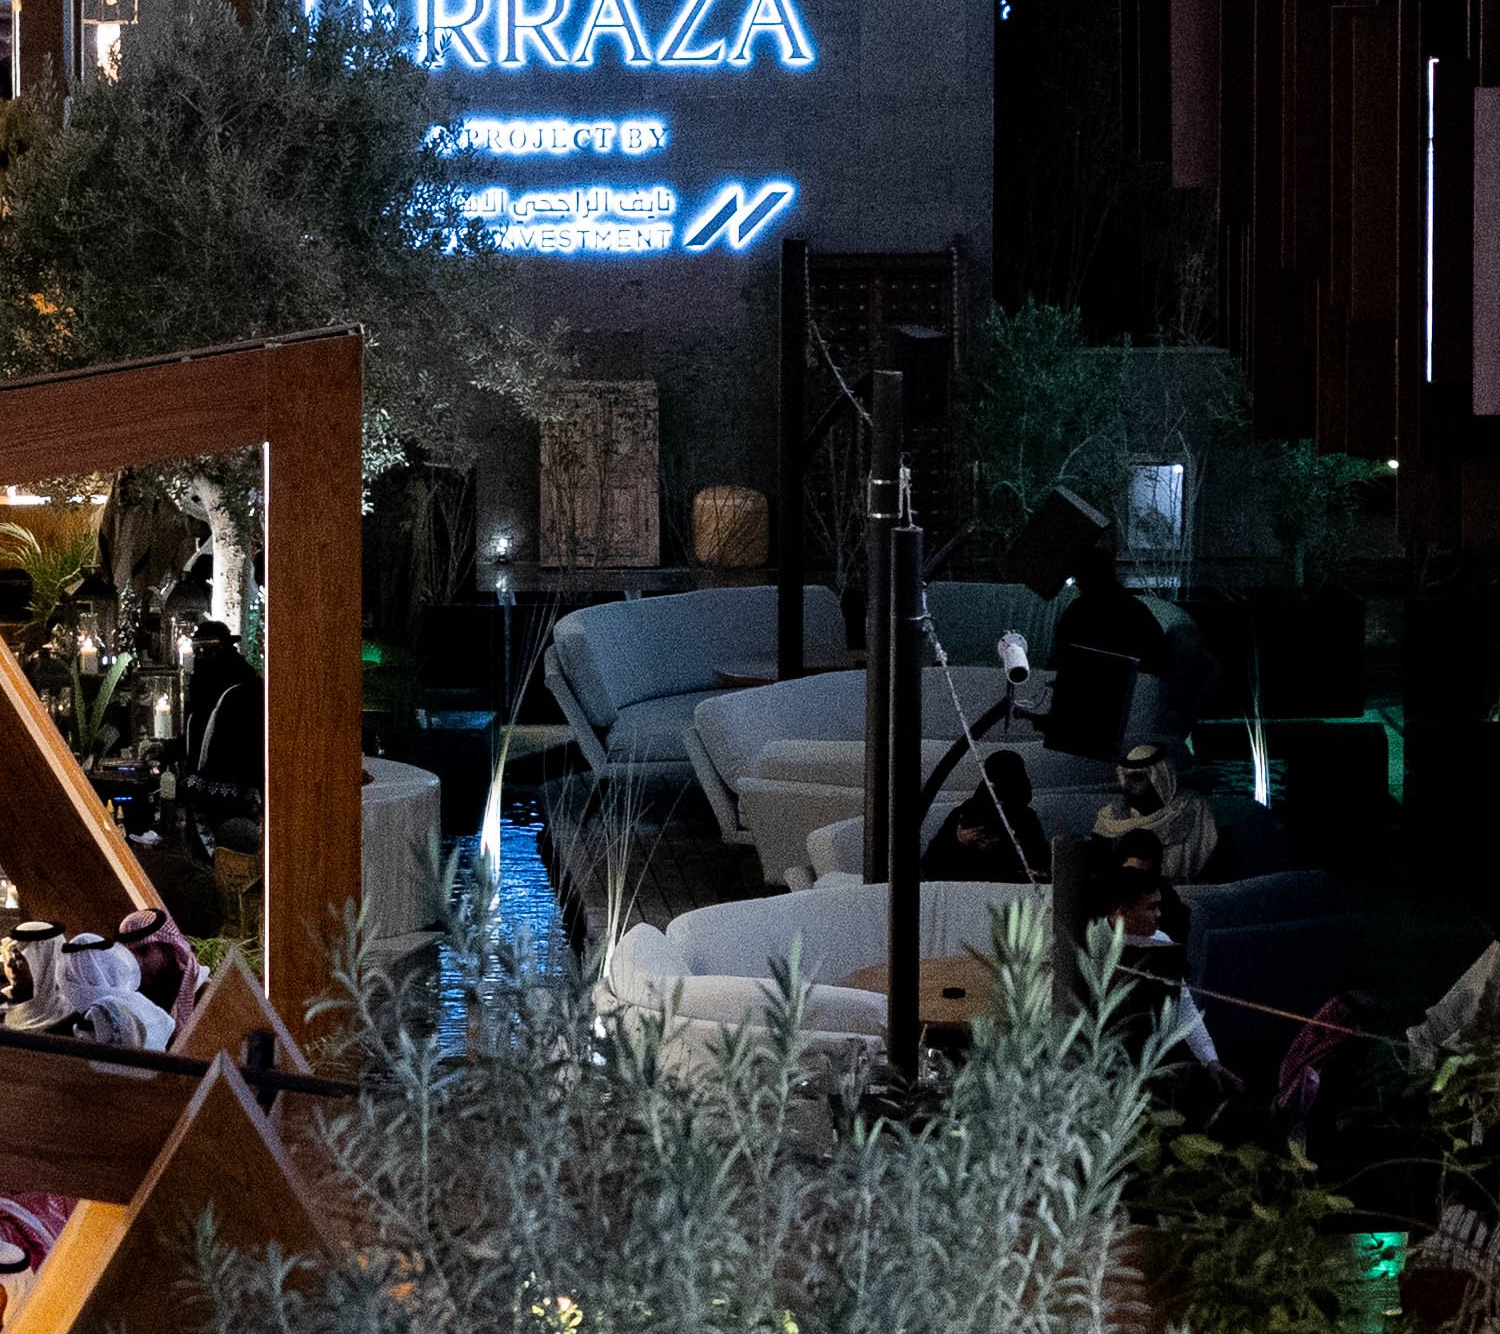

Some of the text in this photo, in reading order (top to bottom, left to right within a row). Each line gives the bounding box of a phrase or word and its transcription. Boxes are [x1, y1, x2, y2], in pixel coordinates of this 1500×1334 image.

[626, 126, 669, 151] BY
[512, 190, 609, 224] الراجحي
[619, 190, 672, 220] نايف
